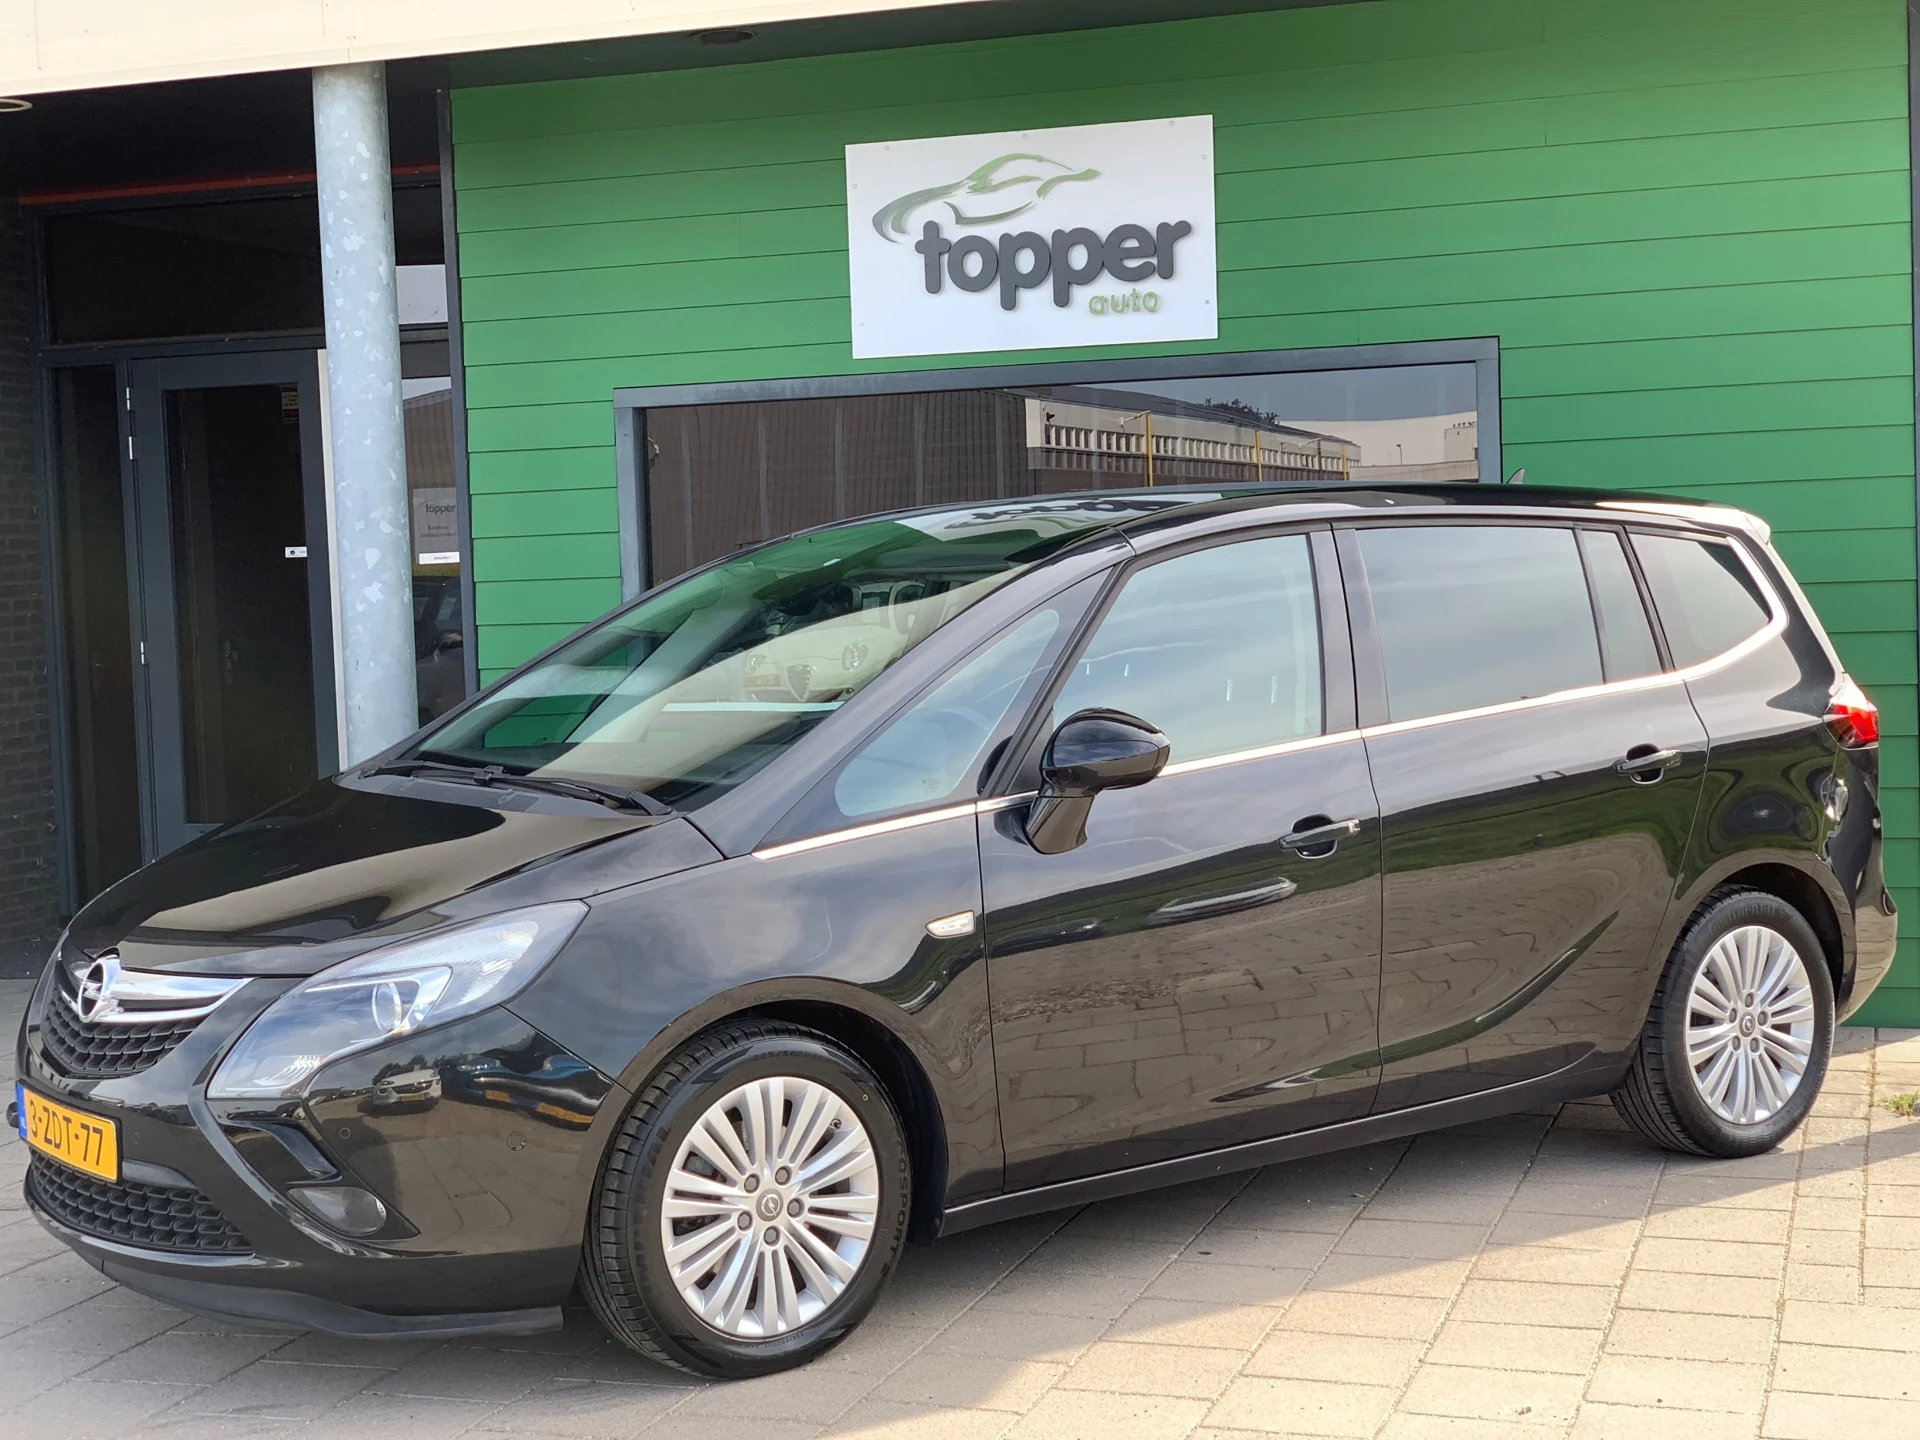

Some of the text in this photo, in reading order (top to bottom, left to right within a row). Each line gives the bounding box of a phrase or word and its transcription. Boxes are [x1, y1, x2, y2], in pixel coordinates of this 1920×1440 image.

[914, 219, 1192, 311] topper
[1088, 287, 1159, 316] auto
[425, 503, 456, 516] topper
[29, 1098, 104, 1167] 3-ZDT-77
